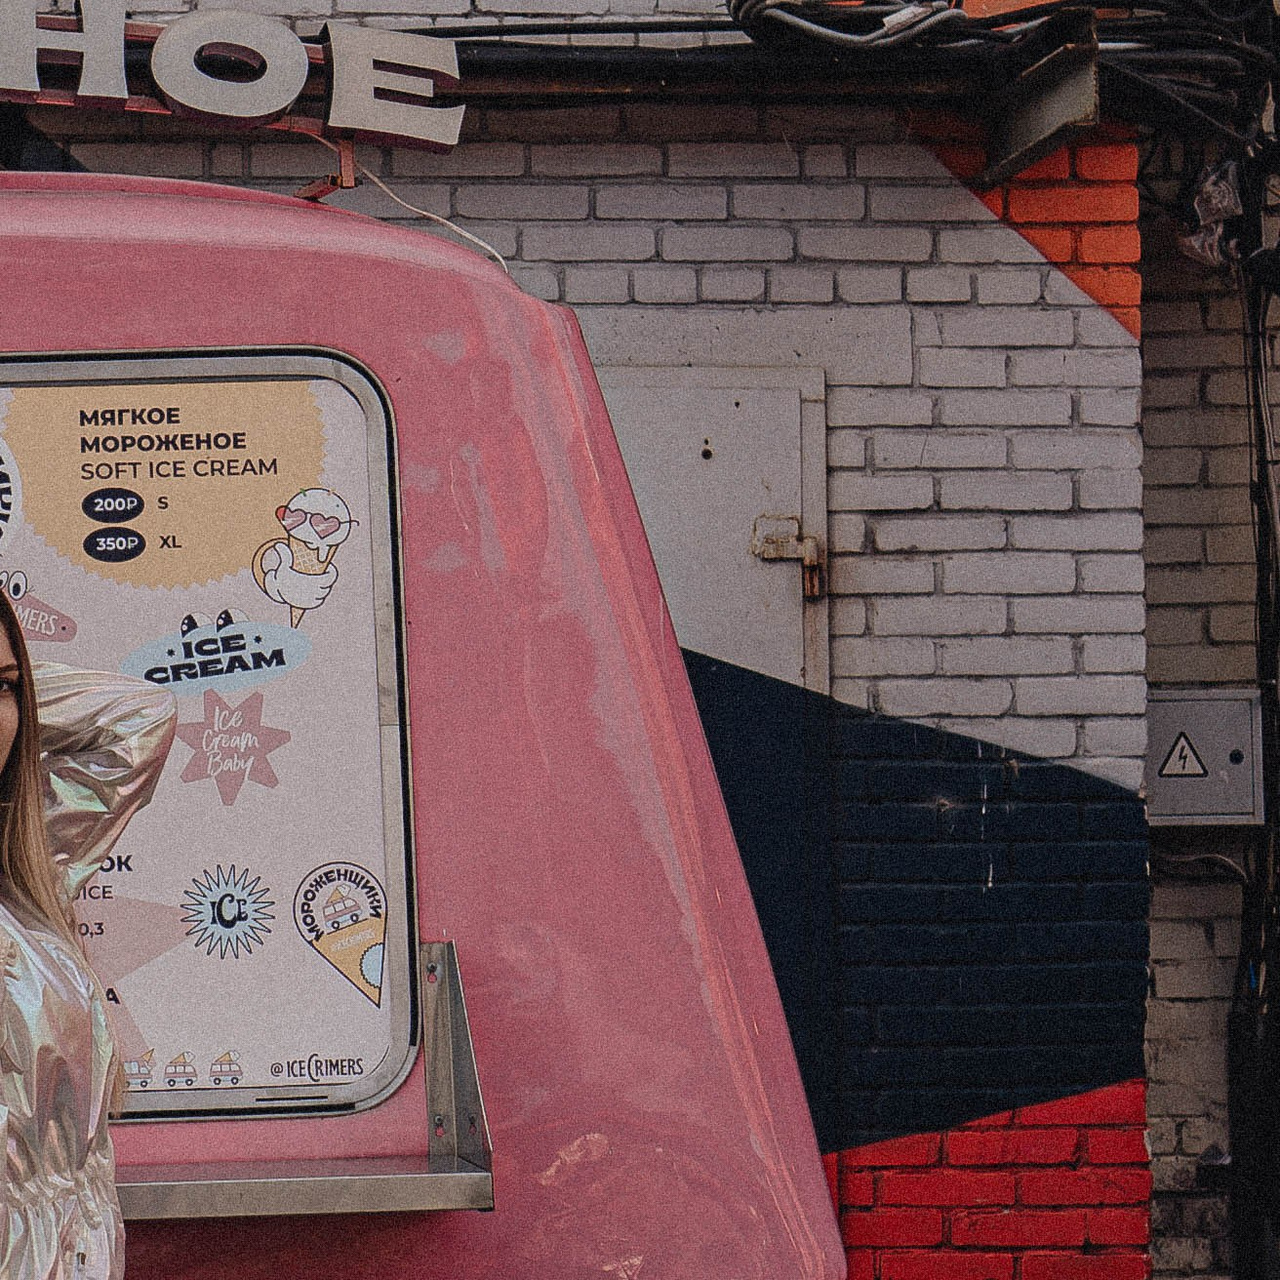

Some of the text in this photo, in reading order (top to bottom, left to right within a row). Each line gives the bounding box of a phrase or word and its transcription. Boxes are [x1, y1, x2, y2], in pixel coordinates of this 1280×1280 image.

[79, 407, 180, 426] МЯГКОЕ
[80, 432, 246, 453] МОРОЖЕНОЕ
[81, 458, 277, 480] SOFT ICE CREAM
[157, 496, 168, 510] S
[159, 535, 182, 548] XL
[182, 634, 246, 659] ICE
[144, 649, 286, 684] CREAM
[214, 705, 243, 732] Ice
[203, 729, 260, 752] Cream
[207, 751, 254, 782] Baby
[210, 893, 248, 929] ICE
[301, 868, 382, 942] МОРОЖЕНЩИКИ
